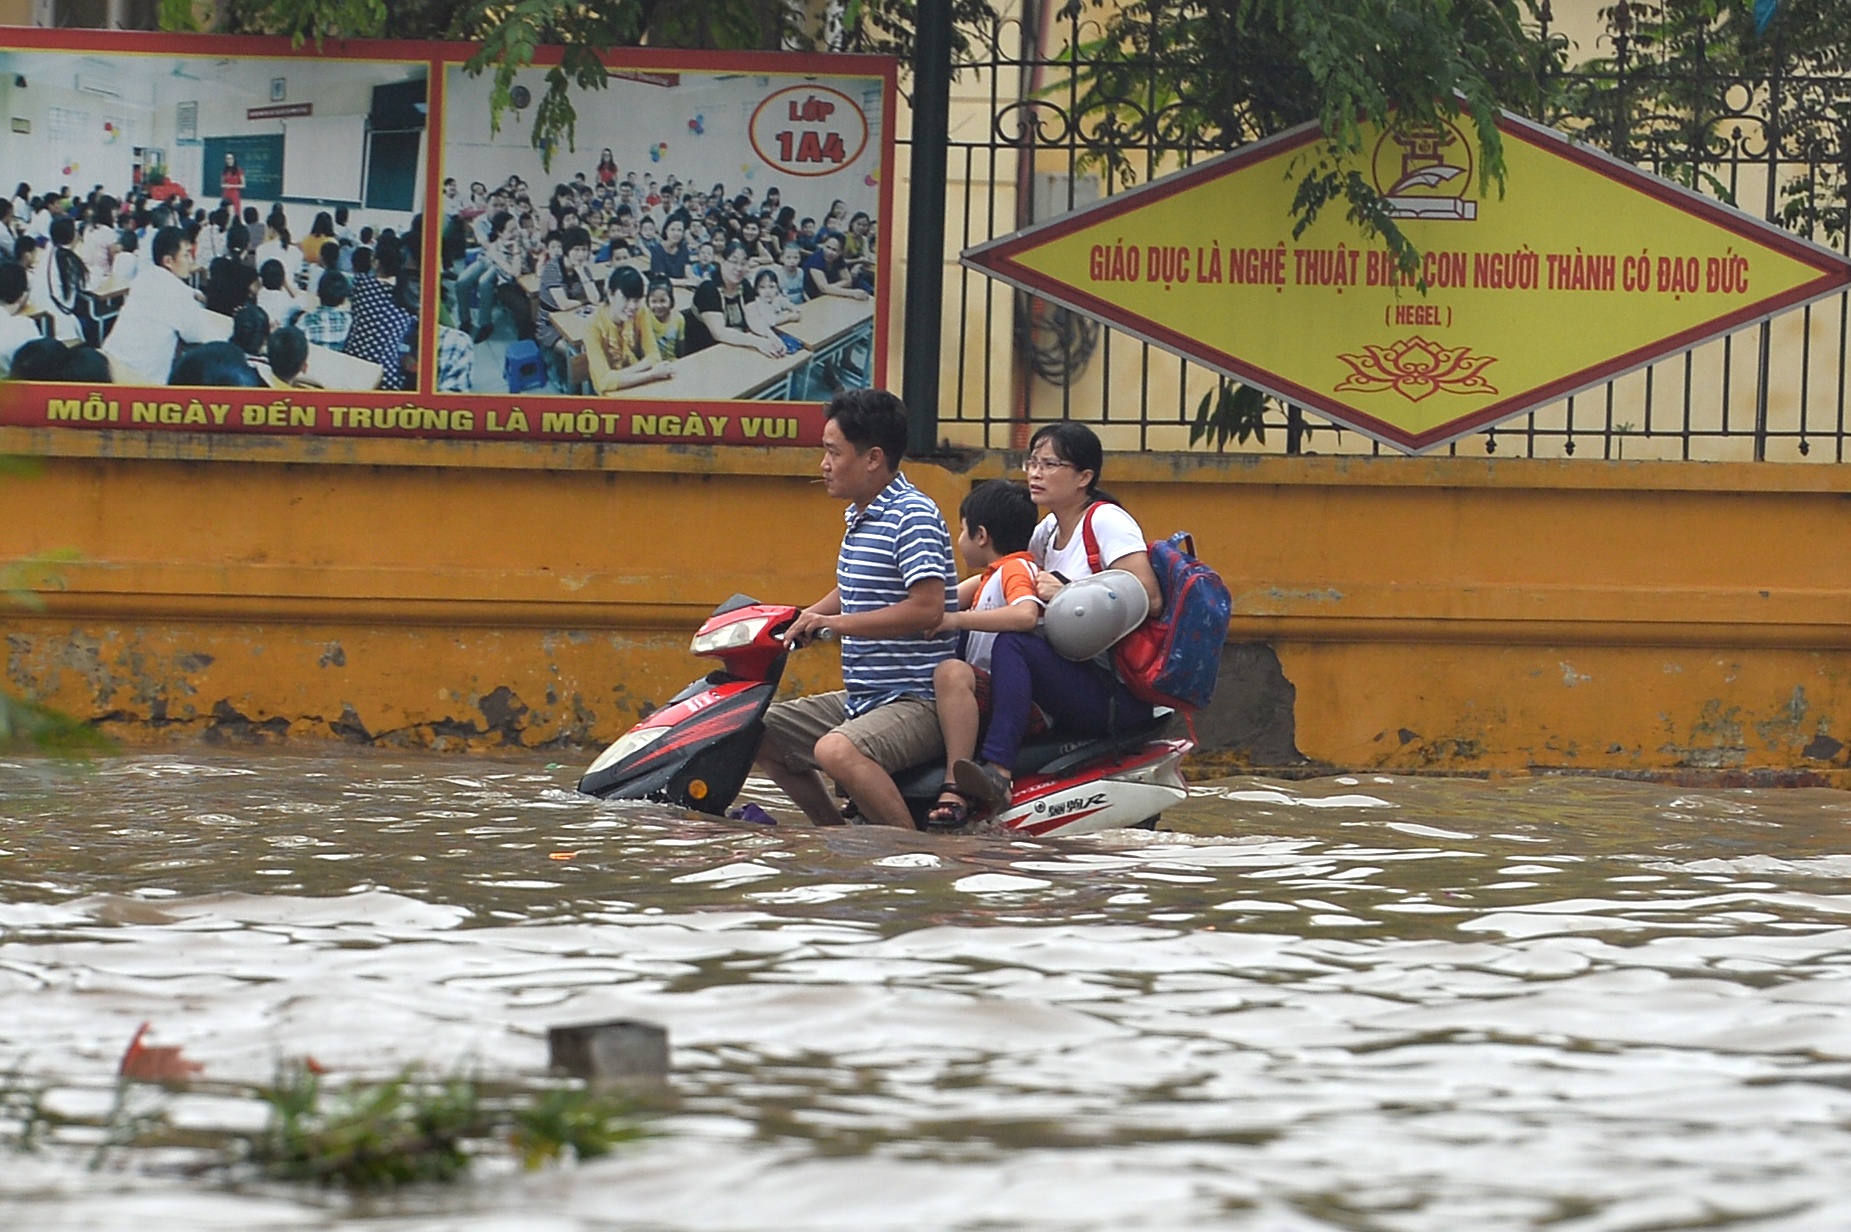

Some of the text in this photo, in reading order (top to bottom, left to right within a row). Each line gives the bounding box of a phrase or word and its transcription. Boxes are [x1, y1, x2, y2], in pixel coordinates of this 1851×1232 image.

[788, 95, 835, 122] LỚP
[775, 130, 846, 163] 1A4
[1089, 237, 1141, 282] GIÁO
[1146, 246, 1191, 291] DỤC
[1196, 239, 1222, 284] LÀ
[1229, 240, 1287, 293] NGHỆ
[1294, 241, 1360, 295] THUẬT
[1423, 251, 1467, 288] CON
[1473, 243, 1540, 290] NGƯỜI
[1546, 246, 1616, 291] THÀNH
[1622, 248, 1651, 292] CÓ
[1657, 256, 1700, 301] ĐẠO
[1706, 246, 1749, 294] ĐỨC
[47, 392, 798, 439] MỖI NGÀY ĐẾN TRƯỜNG LÀ MỘT NGÀY VUI
